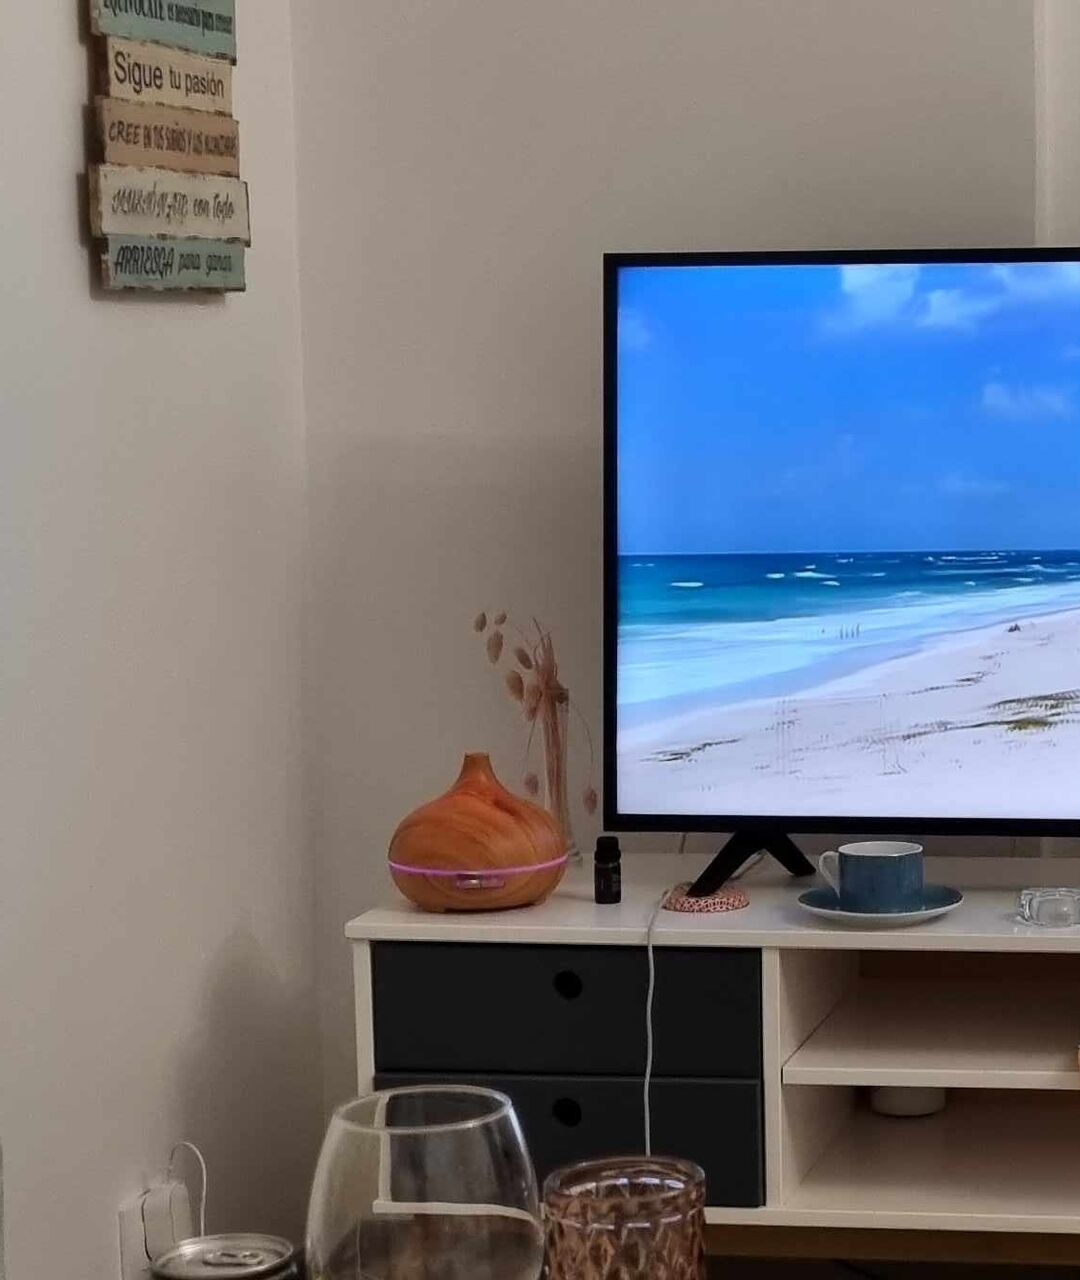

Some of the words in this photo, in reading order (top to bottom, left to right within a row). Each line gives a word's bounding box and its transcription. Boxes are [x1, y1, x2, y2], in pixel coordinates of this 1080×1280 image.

[113, 49, 164, 95] Sigue
[169, 64, 181, 91] tu
[184, 71, 225, 99] pasión
[108, 119, 142, 146] CREE
[113, 244, 175, 281] ARRIESGA
